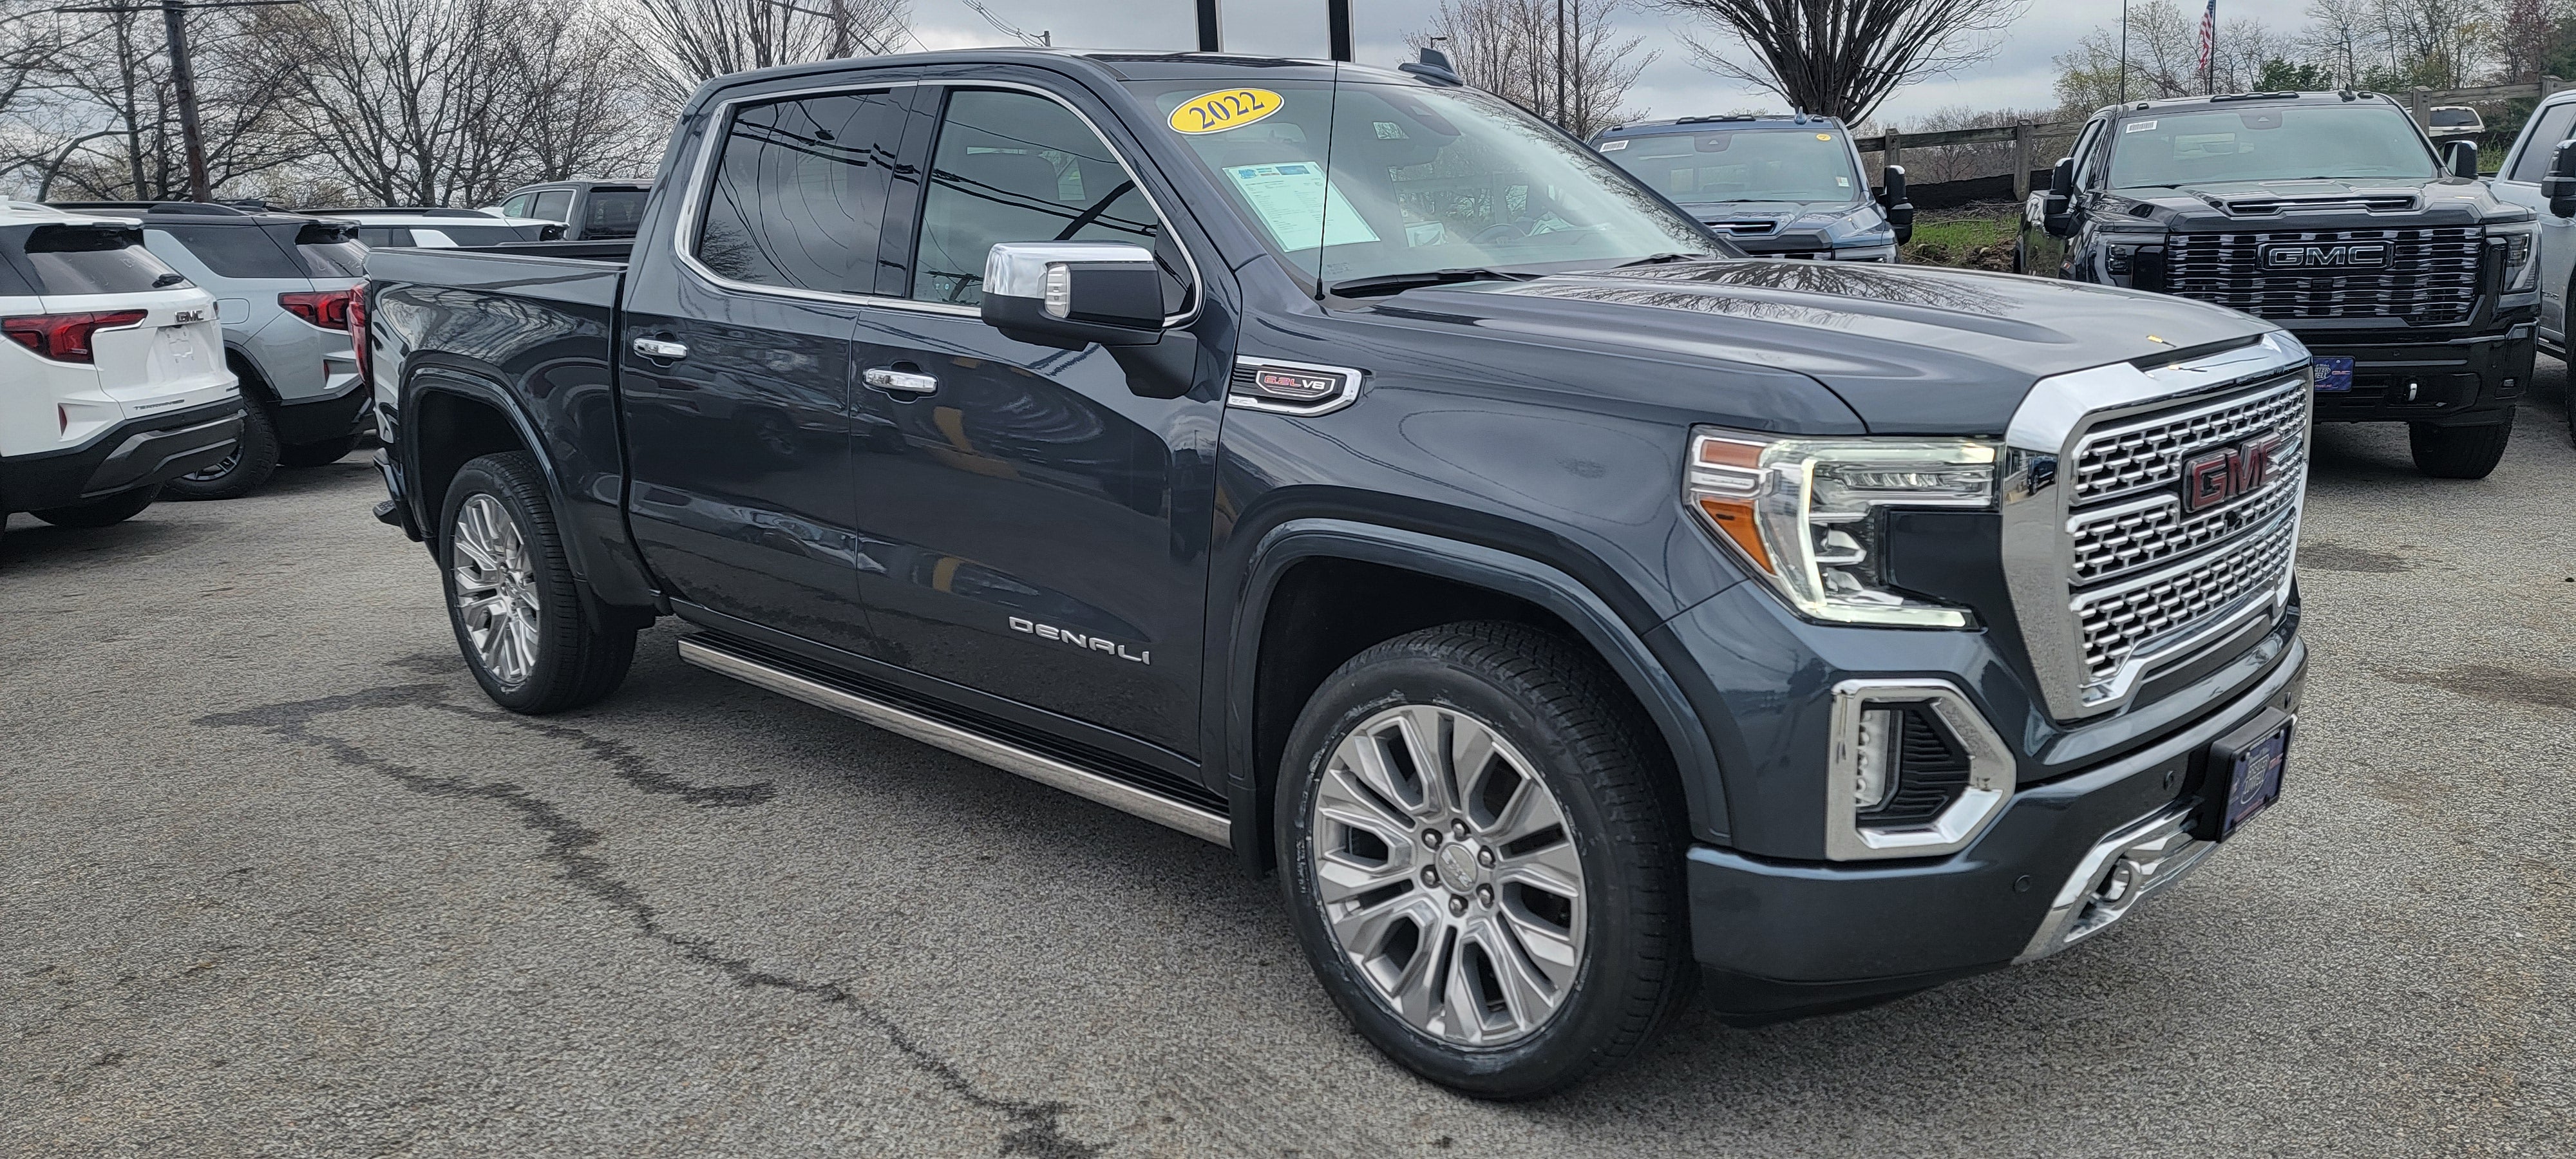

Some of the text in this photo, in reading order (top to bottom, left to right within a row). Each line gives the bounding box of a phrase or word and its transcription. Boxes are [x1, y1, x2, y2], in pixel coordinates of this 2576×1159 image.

[1189, 91, 1265, 129] 2022
[2268, 245, 2384, 267] GMC
[175, 310, 204, 323] GMC
[1264, 375, 1326, 390] 6.2L V8
[2188, 432, 2281, 511] GMC
[1009, 616, 1151, 666] DENALI
